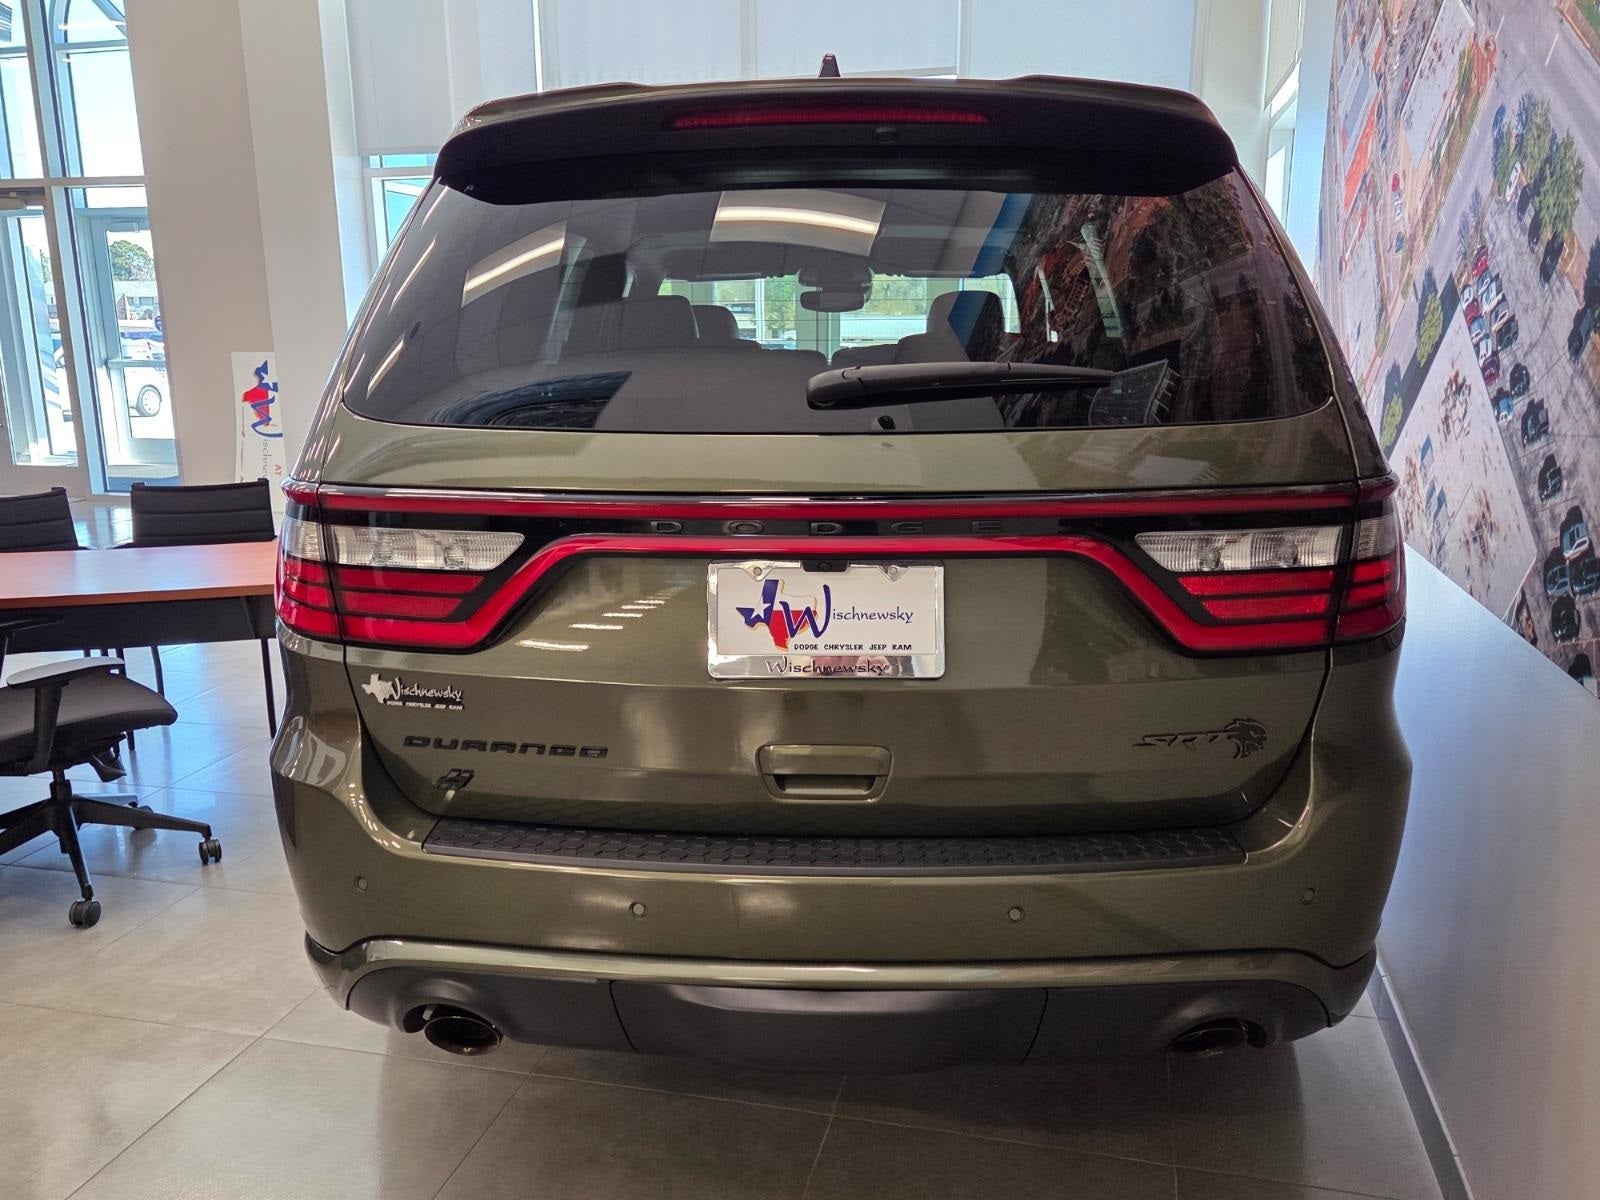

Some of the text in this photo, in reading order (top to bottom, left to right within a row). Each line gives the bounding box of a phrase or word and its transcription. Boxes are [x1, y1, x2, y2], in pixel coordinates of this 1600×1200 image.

[650, 519, 1004, 535] DODGE
[779, 584, 914, 638] Wischnewsky
[793, 643, 912, 651] DODGE CHRYSLER JEEP RAM
[766, 656, 888, 675] Wischnewsky
[403, 735, 609, 758] DURANGO
